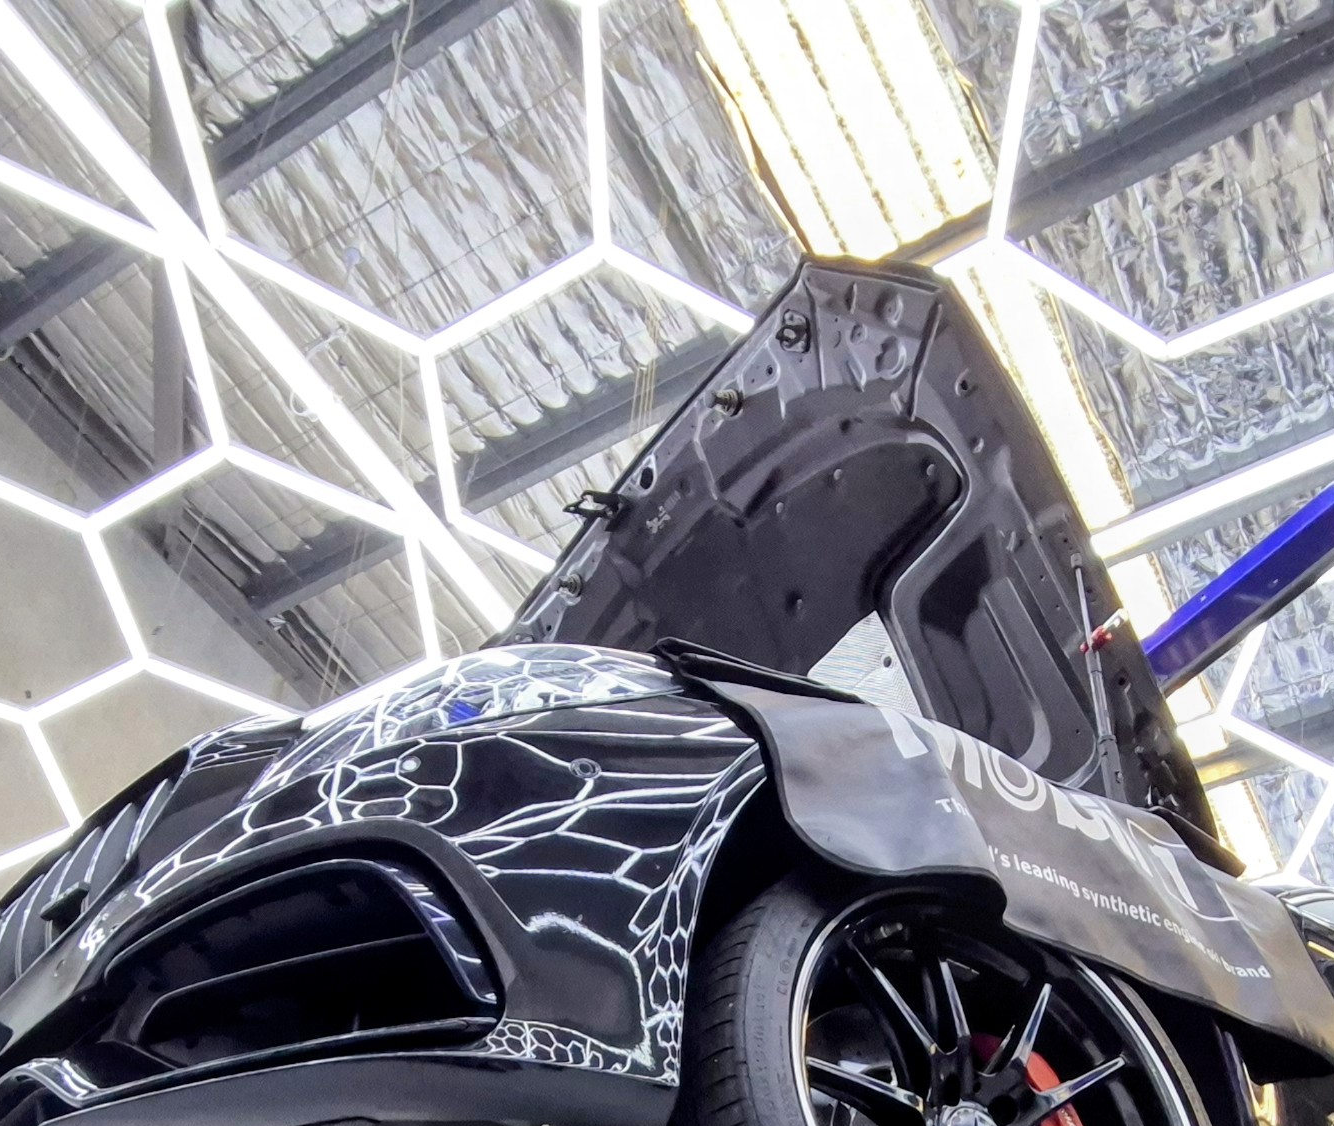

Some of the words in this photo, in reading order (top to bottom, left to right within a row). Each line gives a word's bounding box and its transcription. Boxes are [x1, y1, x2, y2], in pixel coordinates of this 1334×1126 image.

[1014, 854, 1080, 898] leading
[1082, 886, 1161, 927] synthetic
[1220, 956, 1272, 979] brand
